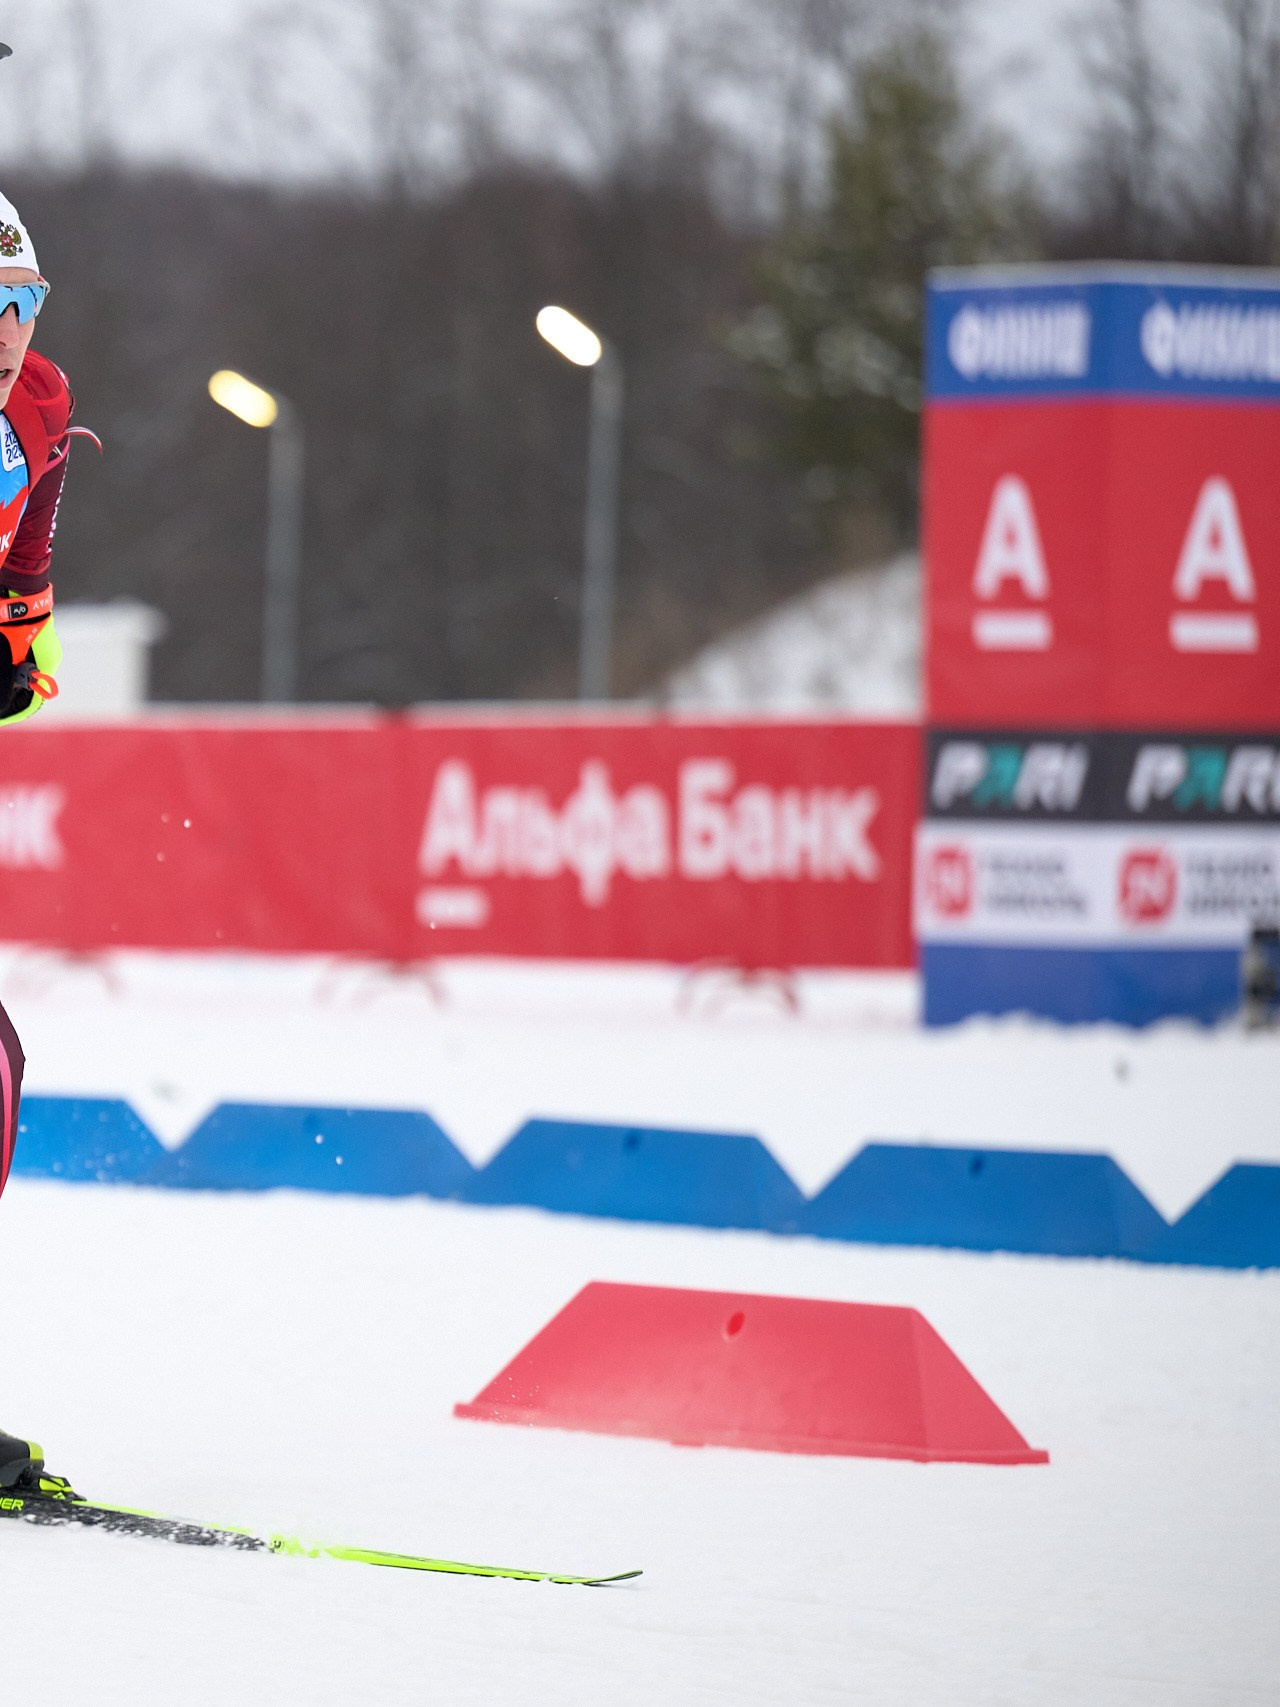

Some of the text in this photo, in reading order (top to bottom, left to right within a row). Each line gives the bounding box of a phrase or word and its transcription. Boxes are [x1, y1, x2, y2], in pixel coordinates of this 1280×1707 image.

[931, 742, 1088, 810] PARI
[418, 756, 882, 908] Альфа Банк
